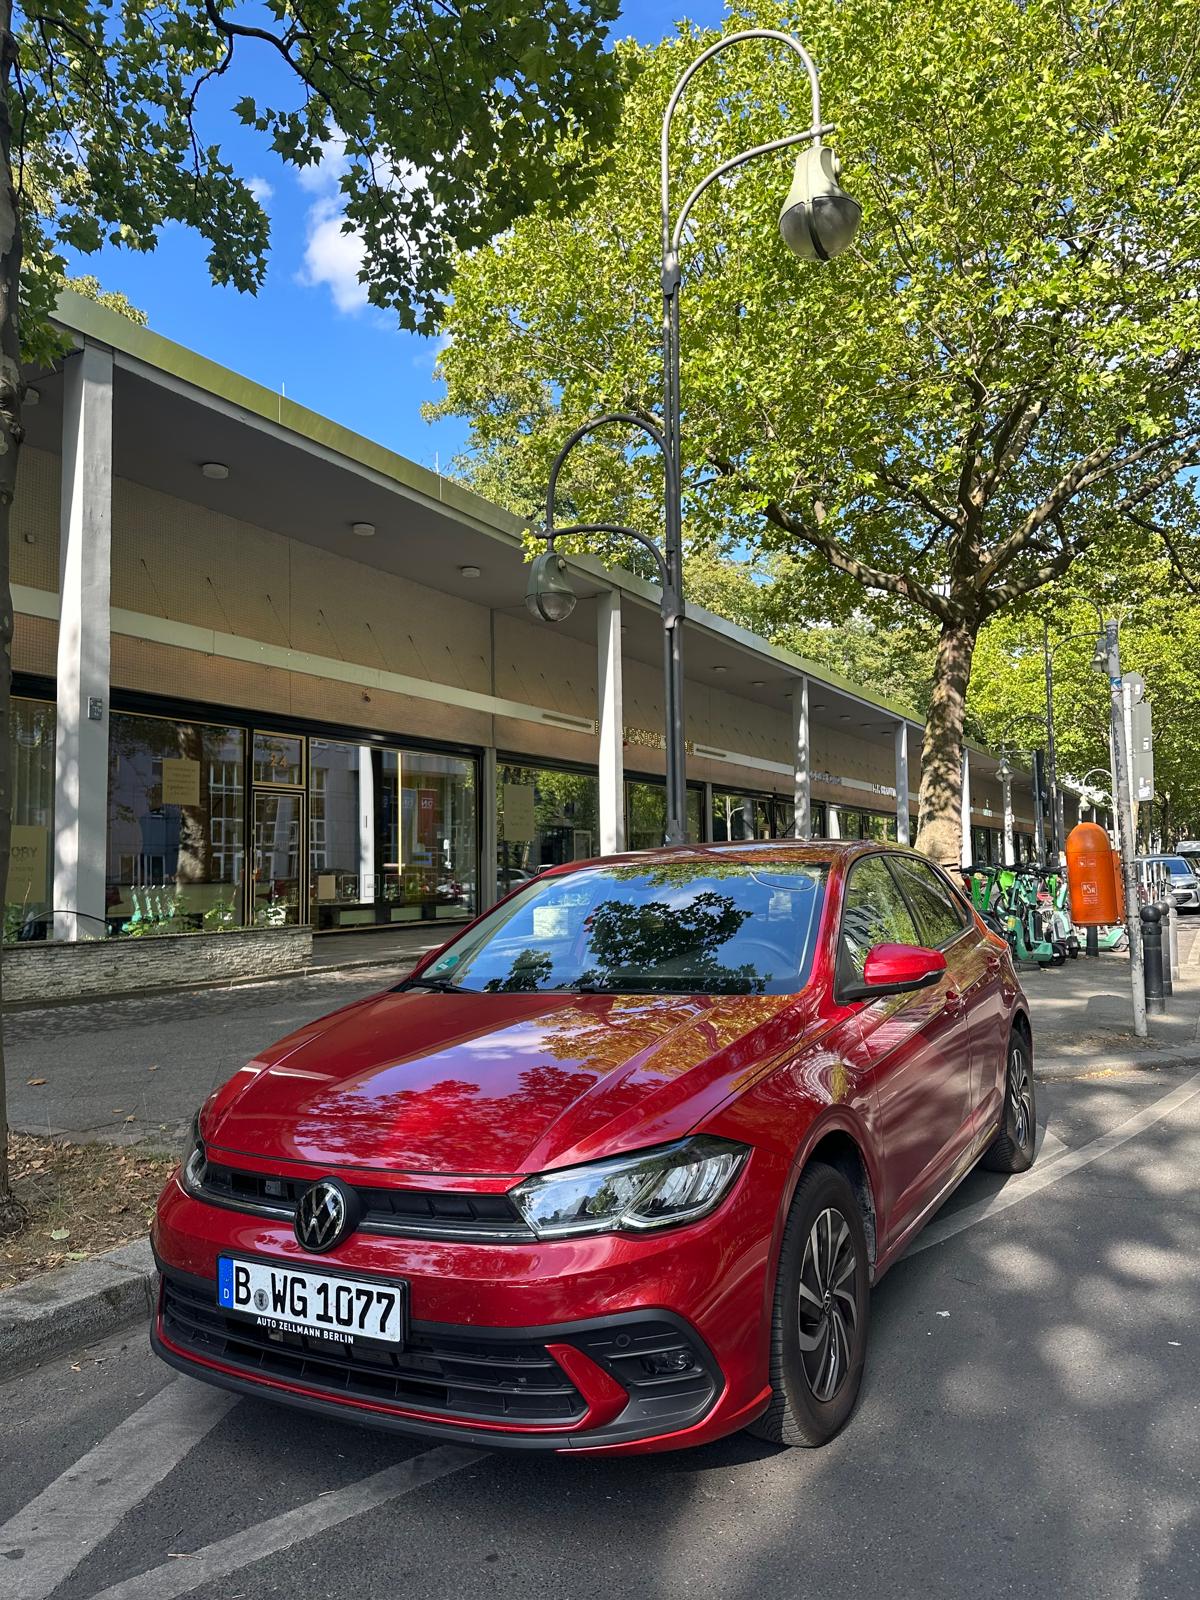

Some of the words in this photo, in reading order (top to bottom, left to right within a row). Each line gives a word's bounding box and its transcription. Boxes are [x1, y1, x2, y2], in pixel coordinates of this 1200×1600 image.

[223, 1287, 230, 1300] D
[234, 1265, 252, 1305] B
[270, 1272, 308, 1318] WG
[315, 1282, 396, 1333] 1077
[256, 1316, 277, 1328] AUTO
[278, 1321, 321, 1338] ZELLMANN
[323, 1330, 354, 1345] BERLIN
